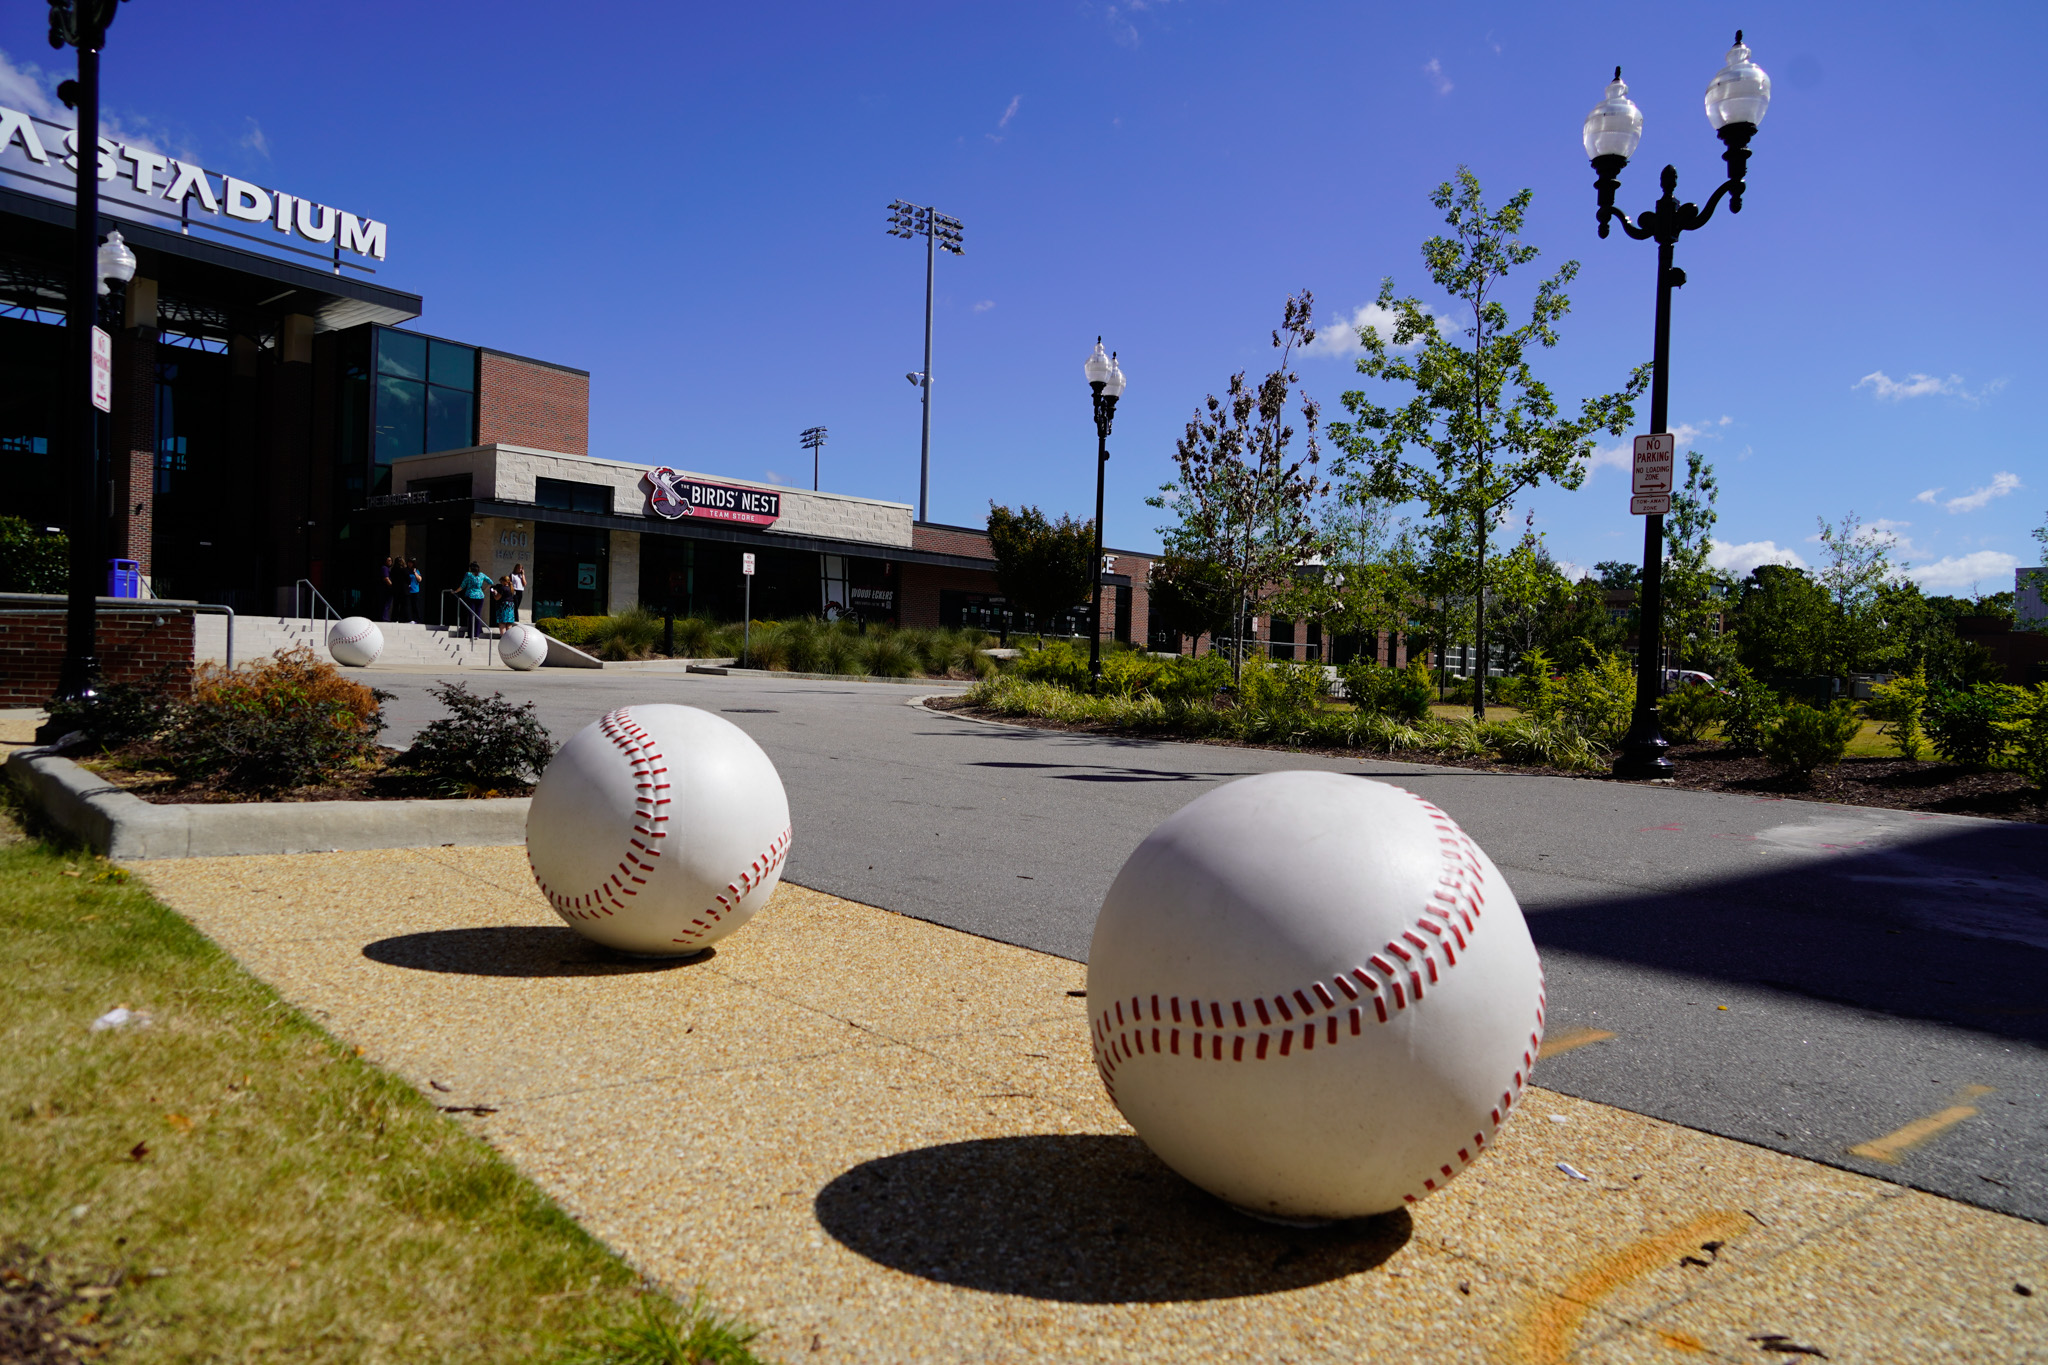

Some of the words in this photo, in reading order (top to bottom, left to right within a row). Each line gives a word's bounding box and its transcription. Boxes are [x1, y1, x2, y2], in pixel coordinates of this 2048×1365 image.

[59, 129, 387, 262] STADIUM
[1646, 440, 1660, 450] NO
[1637, 452, 1669, 463] PARKING
[1635, 466, 1644, 474] NO
[1646, 466, 1669, 474] LOADING
[691, 485, 738, 508] BIRDS'
[742, 492, 778, 514] NEST
[709, 509, 730, 519] TEAM
[732, 513, 755, 522] STORE
[501, 529, 528, 548] 460
[496, 550, 515, 560] HAY
